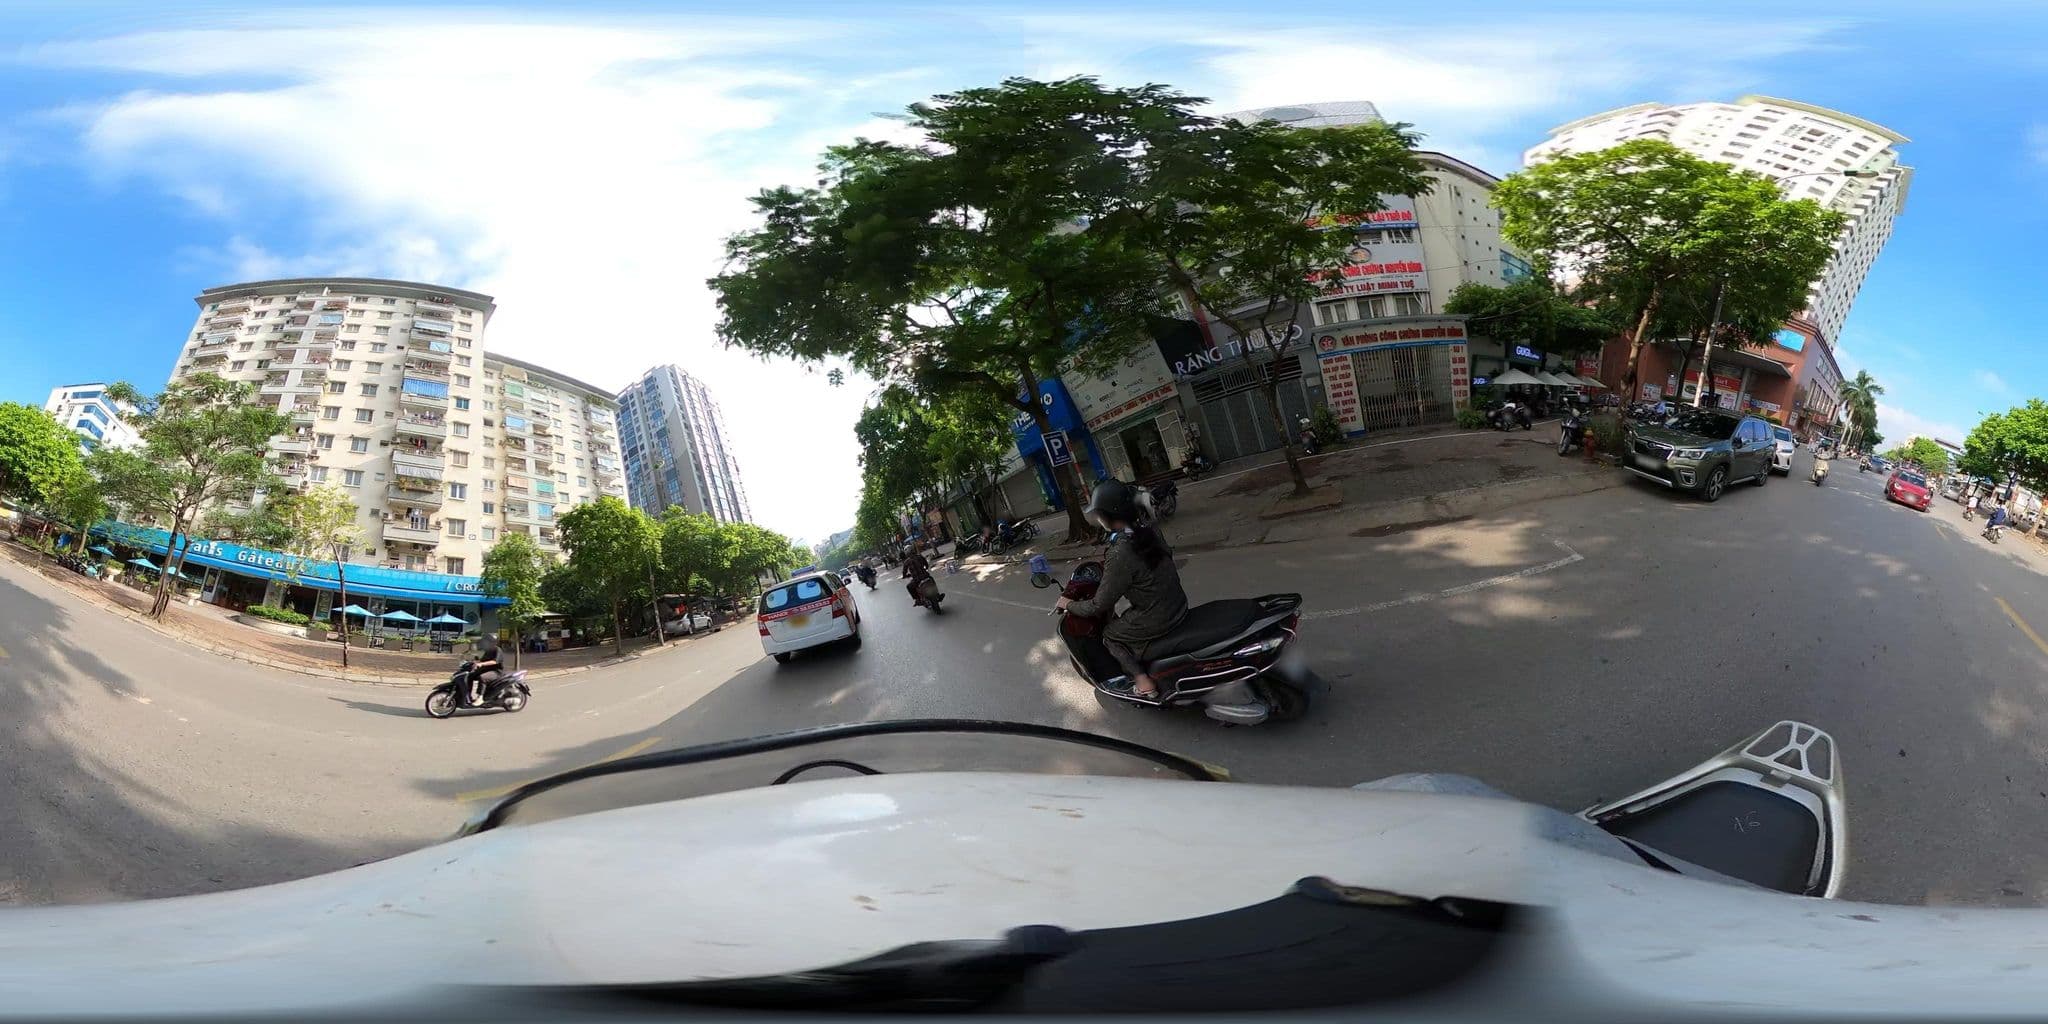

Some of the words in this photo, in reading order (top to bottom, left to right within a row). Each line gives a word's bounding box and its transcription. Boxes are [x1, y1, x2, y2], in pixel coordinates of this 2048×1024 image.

[1345, 284, 1356, 293] TY
[1356, 282, 1375, 293] LUẬT
[1377, 281, 1398, 290] MINH
[1400, 279, 1415, 289] TUỆ
[1341, 335, 1355, 347] VĂN
[1356, 332, 1379, 346] PHÒNG
[1379, 330, 1398, 341] CÔNG
[1398, 328, 1420, 340] CHỨNG
[1175, 346, 1223, 376] RĂNG
[1049, 438, 1063, 456] P
[190, 540, 223, 556] aris
